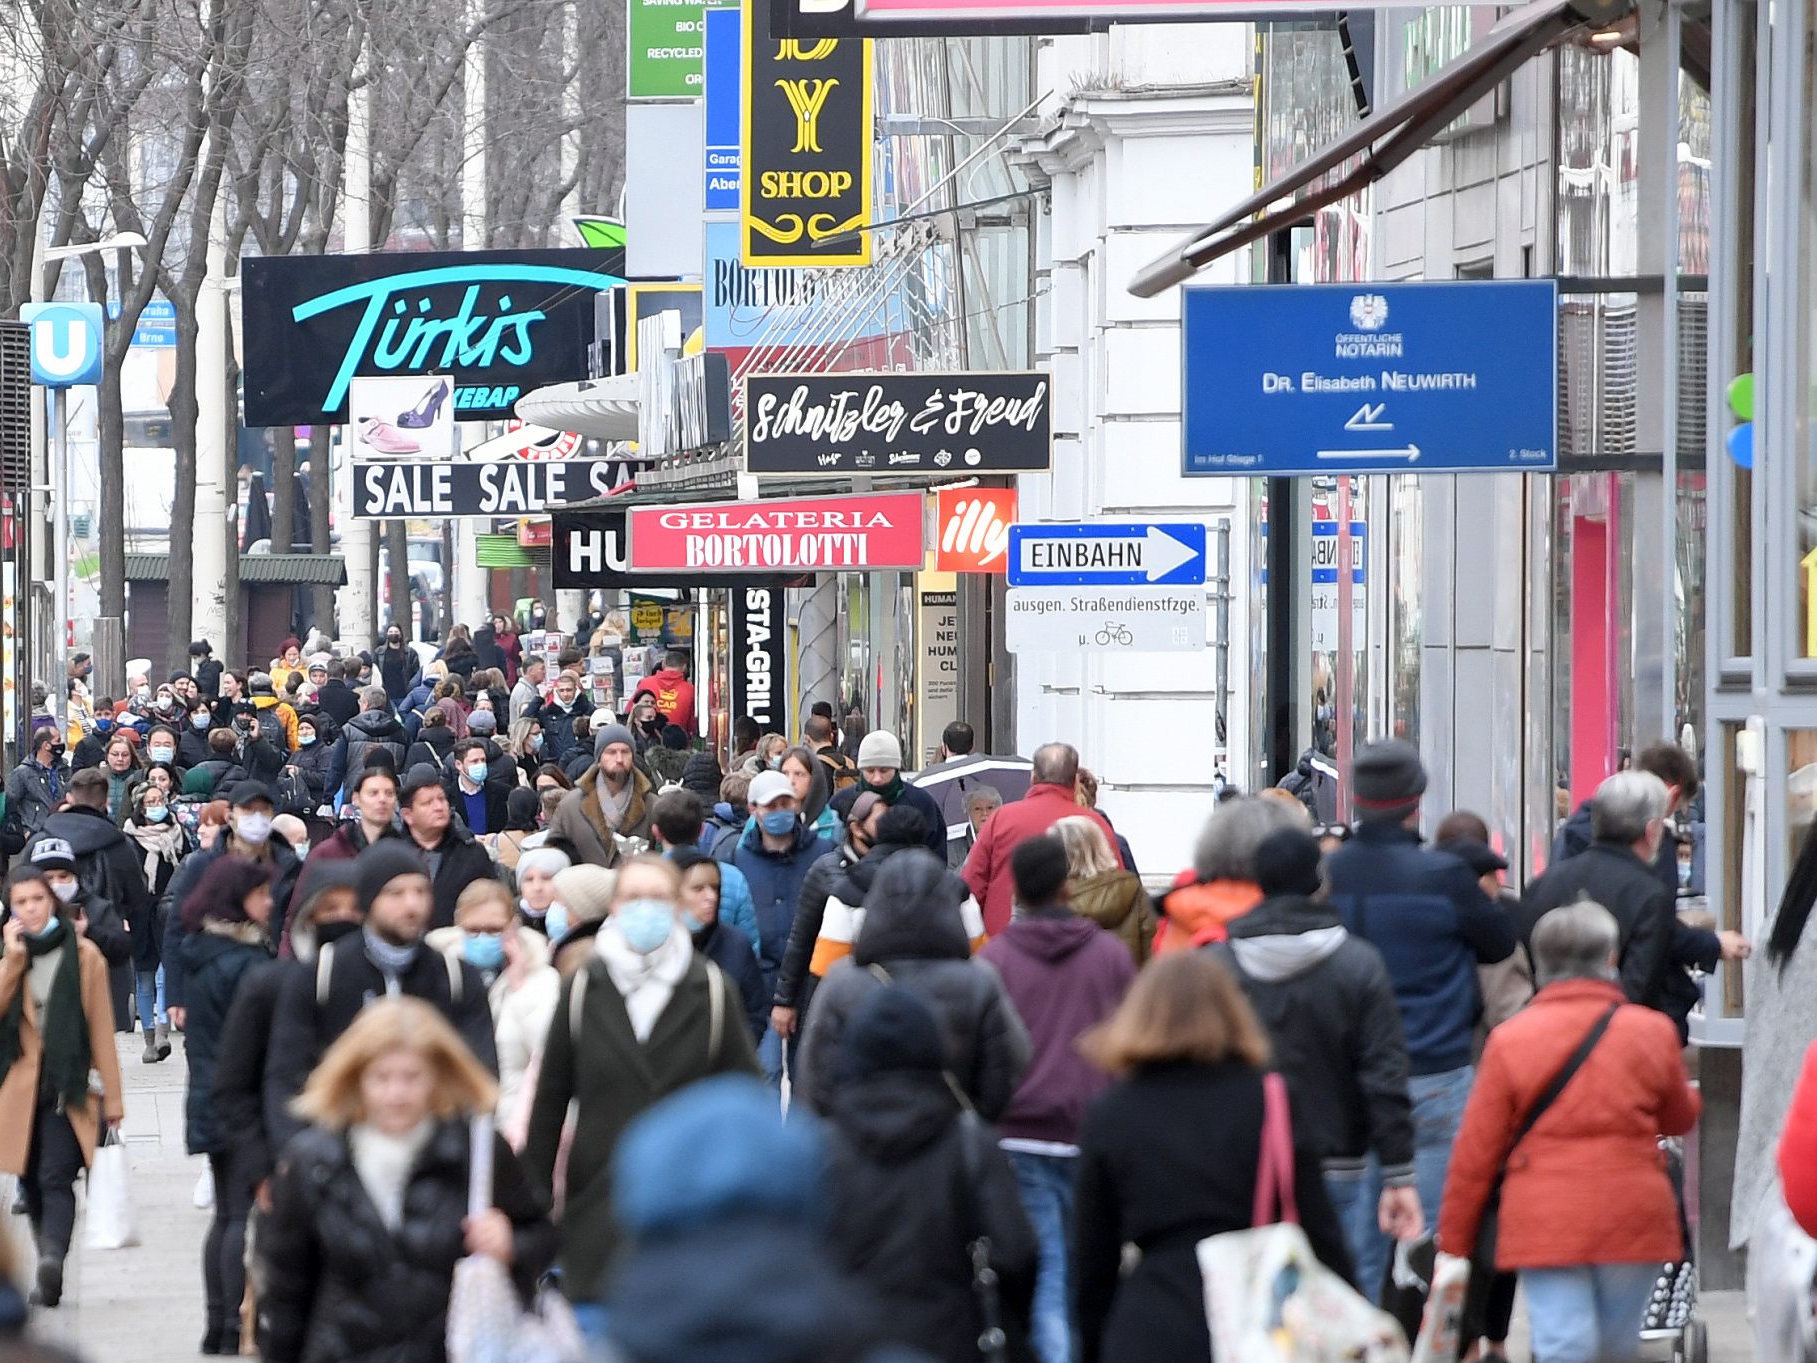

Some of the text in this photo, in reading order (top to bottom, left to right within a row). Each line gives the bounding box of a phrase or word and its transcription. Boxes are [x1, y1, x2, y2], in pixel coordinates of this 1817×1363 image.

[675, 21, 695, 32] BIO
[647, 47, 703, 59] RECYCLED
[760, 171, 853, 198] SHOP
[35, 320, 87, 376] U
[1335, 333, 1403, 344] ÖFFENTLICHE
[1335, 343, 1404, 359] NOTARIN
[1381, 370, 1478, 391] NEUWIRTH
[752, 381, 1047, 443] Schnitzler & Freud
[365, 465, 453, 513] SALE
[479, 462, 566, 512] SALE
[659, 511, 894, 530] GELATERIA
[942, 499, 1010, 566] illy
[685, 533, 868, 567] BORTOLOTTI
[1031, 542, 1142, 567] EINBAHN
[1012, 597, 1200, 615] ausgen. Straßendienstfzge.
